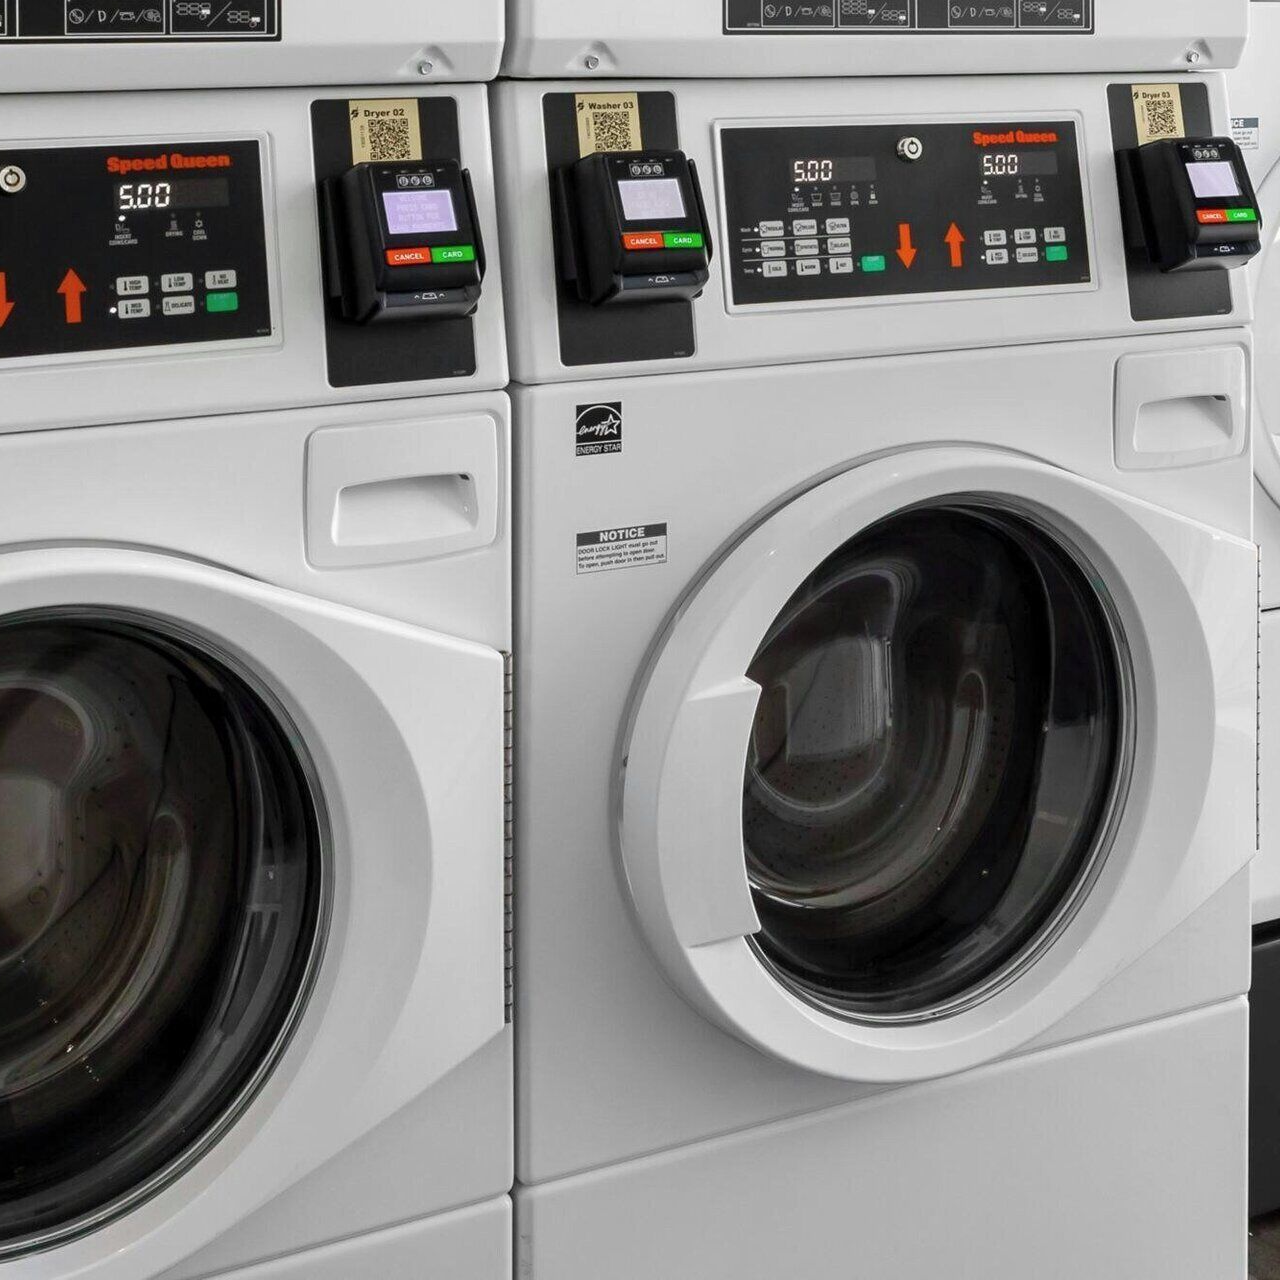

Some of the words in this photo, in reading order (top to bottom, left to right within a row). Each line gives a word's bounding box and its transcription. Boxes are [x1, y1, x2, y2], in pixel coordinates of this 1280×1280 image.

[1142, 91, 1161, 100] Dryer
[588, 102, 621, 110] Washer
[623, 101, 634, 109] 03
[364, 109, 390, 119] Dryer
[973, 131, 1014, 146] Speed
[1016, 130, 1057, 143] Queen
[107, 154, 167, 174] Speed
[171, 154, 231, 168] Queen
[983, 154, 1018, 175] 5.00
[794, 160, 833, 182] 5.00
[120, 183, 170, 209] 5.00
[394, 252, 424, 261] CANCEL
[442, 250, 463, 259] CARD
[578, 424, 608, 436] energy
[576, 445, 602, 455] ENERGY
[604, 443, 621, 453] STAR
[599, 527, 645, 542] NOTICE
[612, 543, 627, 551] LIGHT
